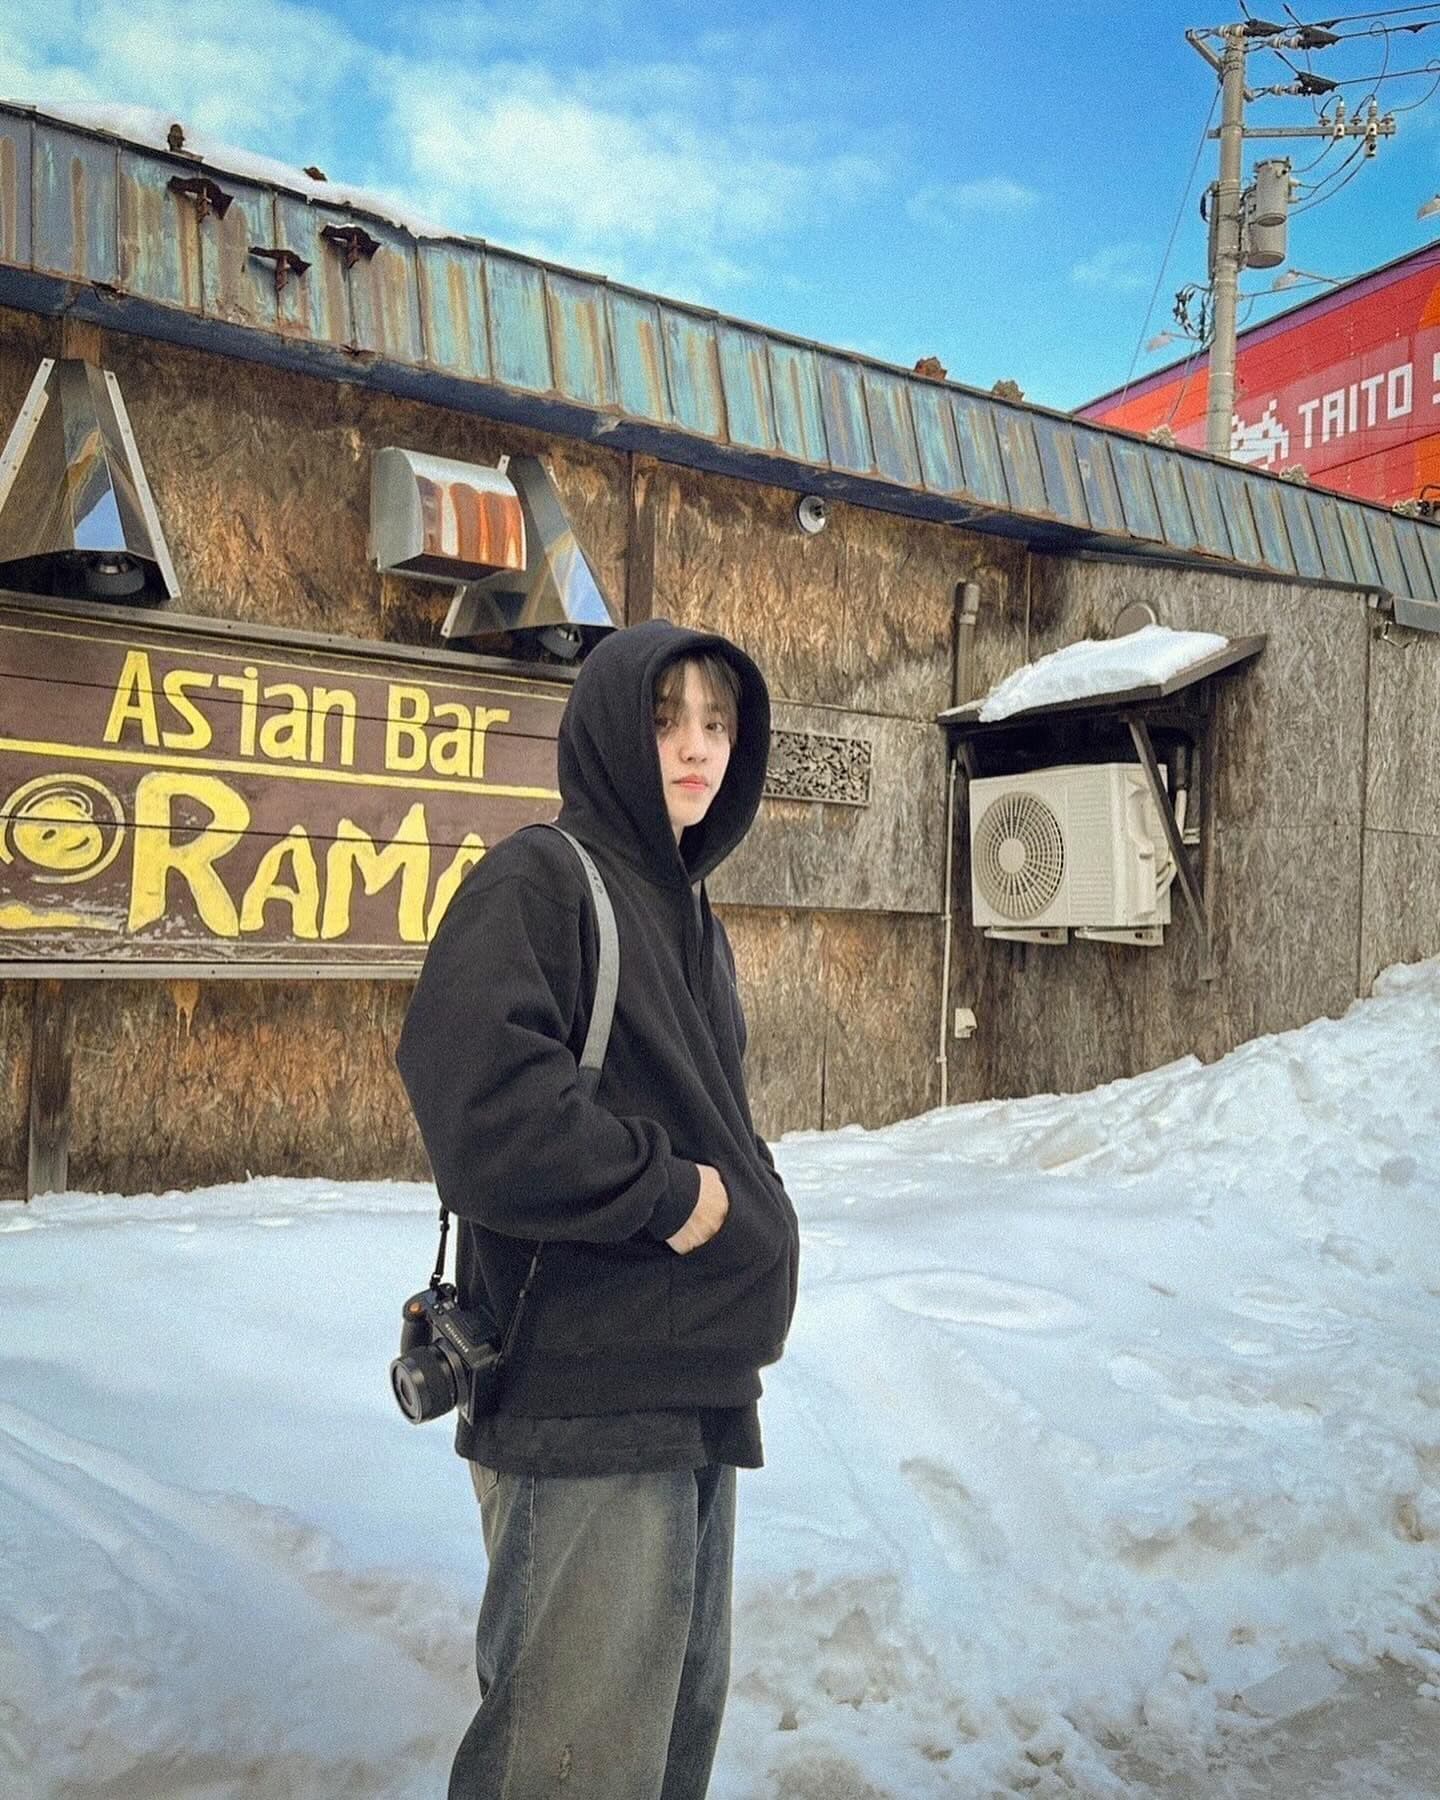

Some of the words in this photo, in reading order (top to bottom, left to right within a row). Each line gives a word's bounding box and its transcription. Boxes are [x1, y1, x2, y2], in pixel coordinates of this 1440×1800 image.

[1298, 362, 1413, 449] TAITO
[103, 650, 356, 767] Asian
[384, 683, 511, 779] Bar
